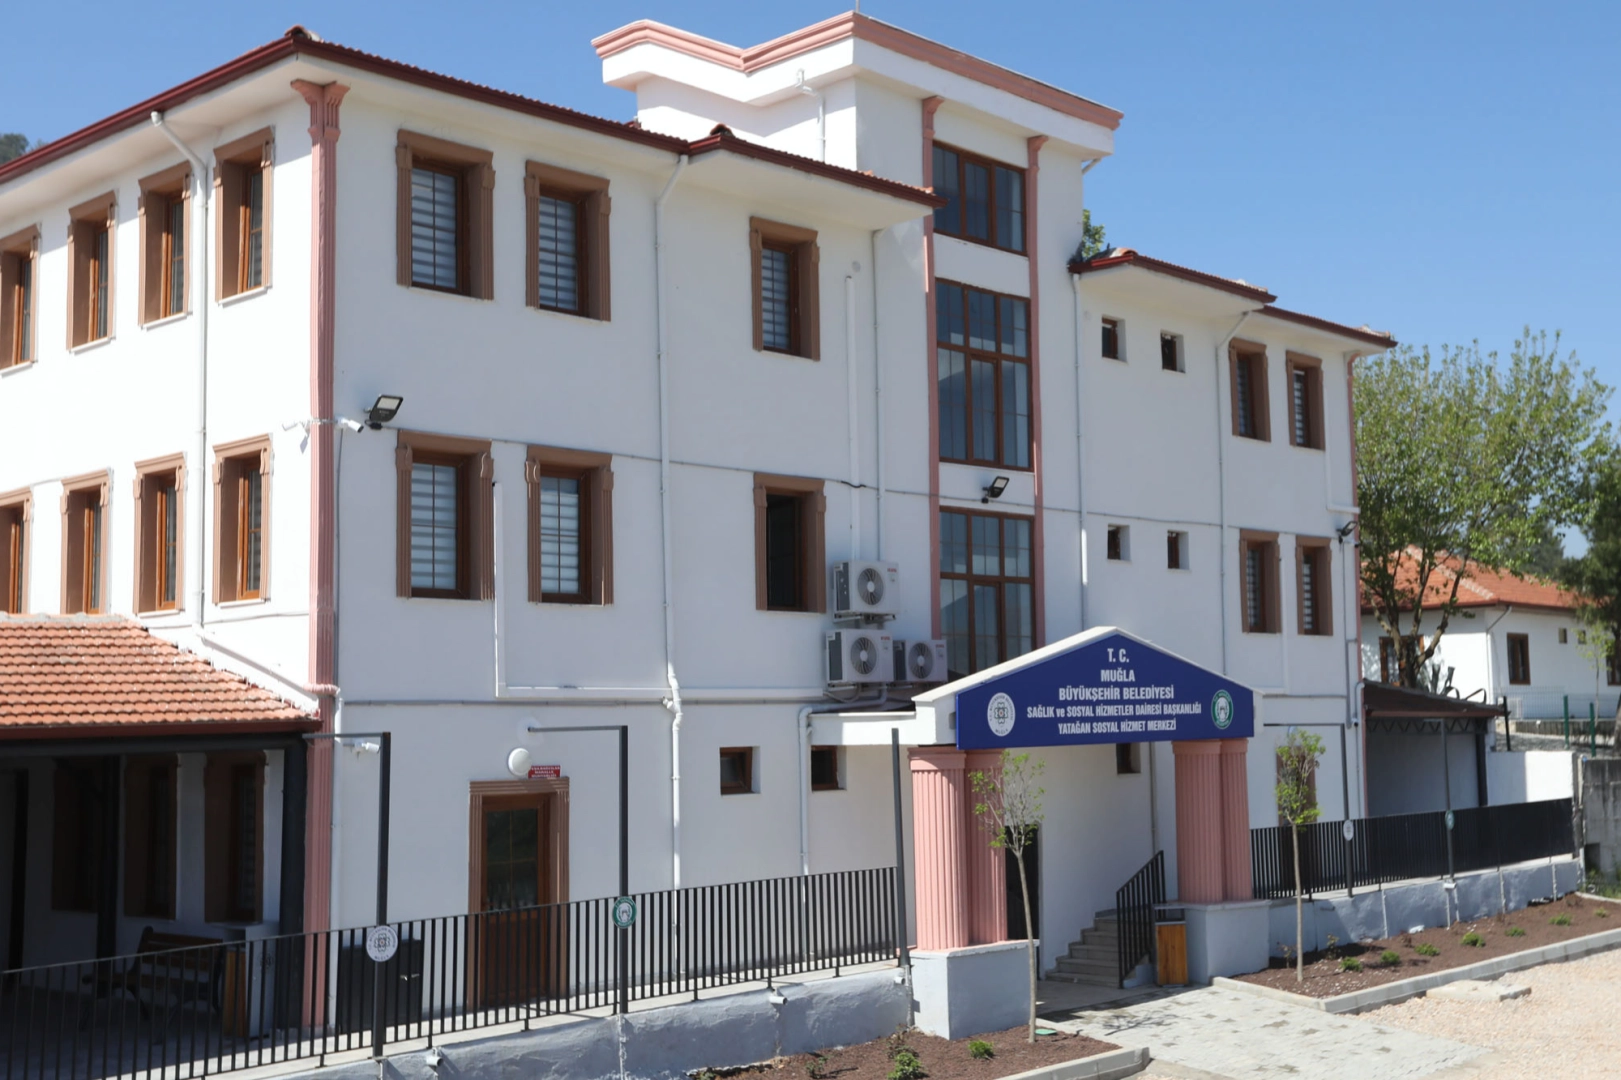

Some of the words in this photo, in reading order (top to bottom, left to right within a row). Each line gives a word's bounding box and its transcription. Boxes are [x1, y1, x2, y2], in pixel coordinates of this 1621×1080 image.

[1108, 648, 1115, 662] T.
[1119, 648, 1129, 662] C.
[1101, 668, 1135, 682] MUĞLA
[1059, 686, 1120, 702] BÜYÜKŞEHİR
[1123, 685, 1174, 699] BELEDİYESİ
[1027, 704, 1054, 718] SAĞLIK
[1056, 708, 1065, 717] ve
[1067, 706, 1094, 717] SOSYAL
[1096, 703, 1134, 716] HİZMETLER
[1136, 702, 1161, 715] DAİRESİ
[1163, 702, 1201, 715] BAŞKANLIĞI
[1058, 721, 1090, 734] YATAĞAN
[1093, 721, 1119, 733] SOSYAL
[1121, 719, 1145, 732] HİZMET
[1147, 718, 1176, 731] MERKEZİ
